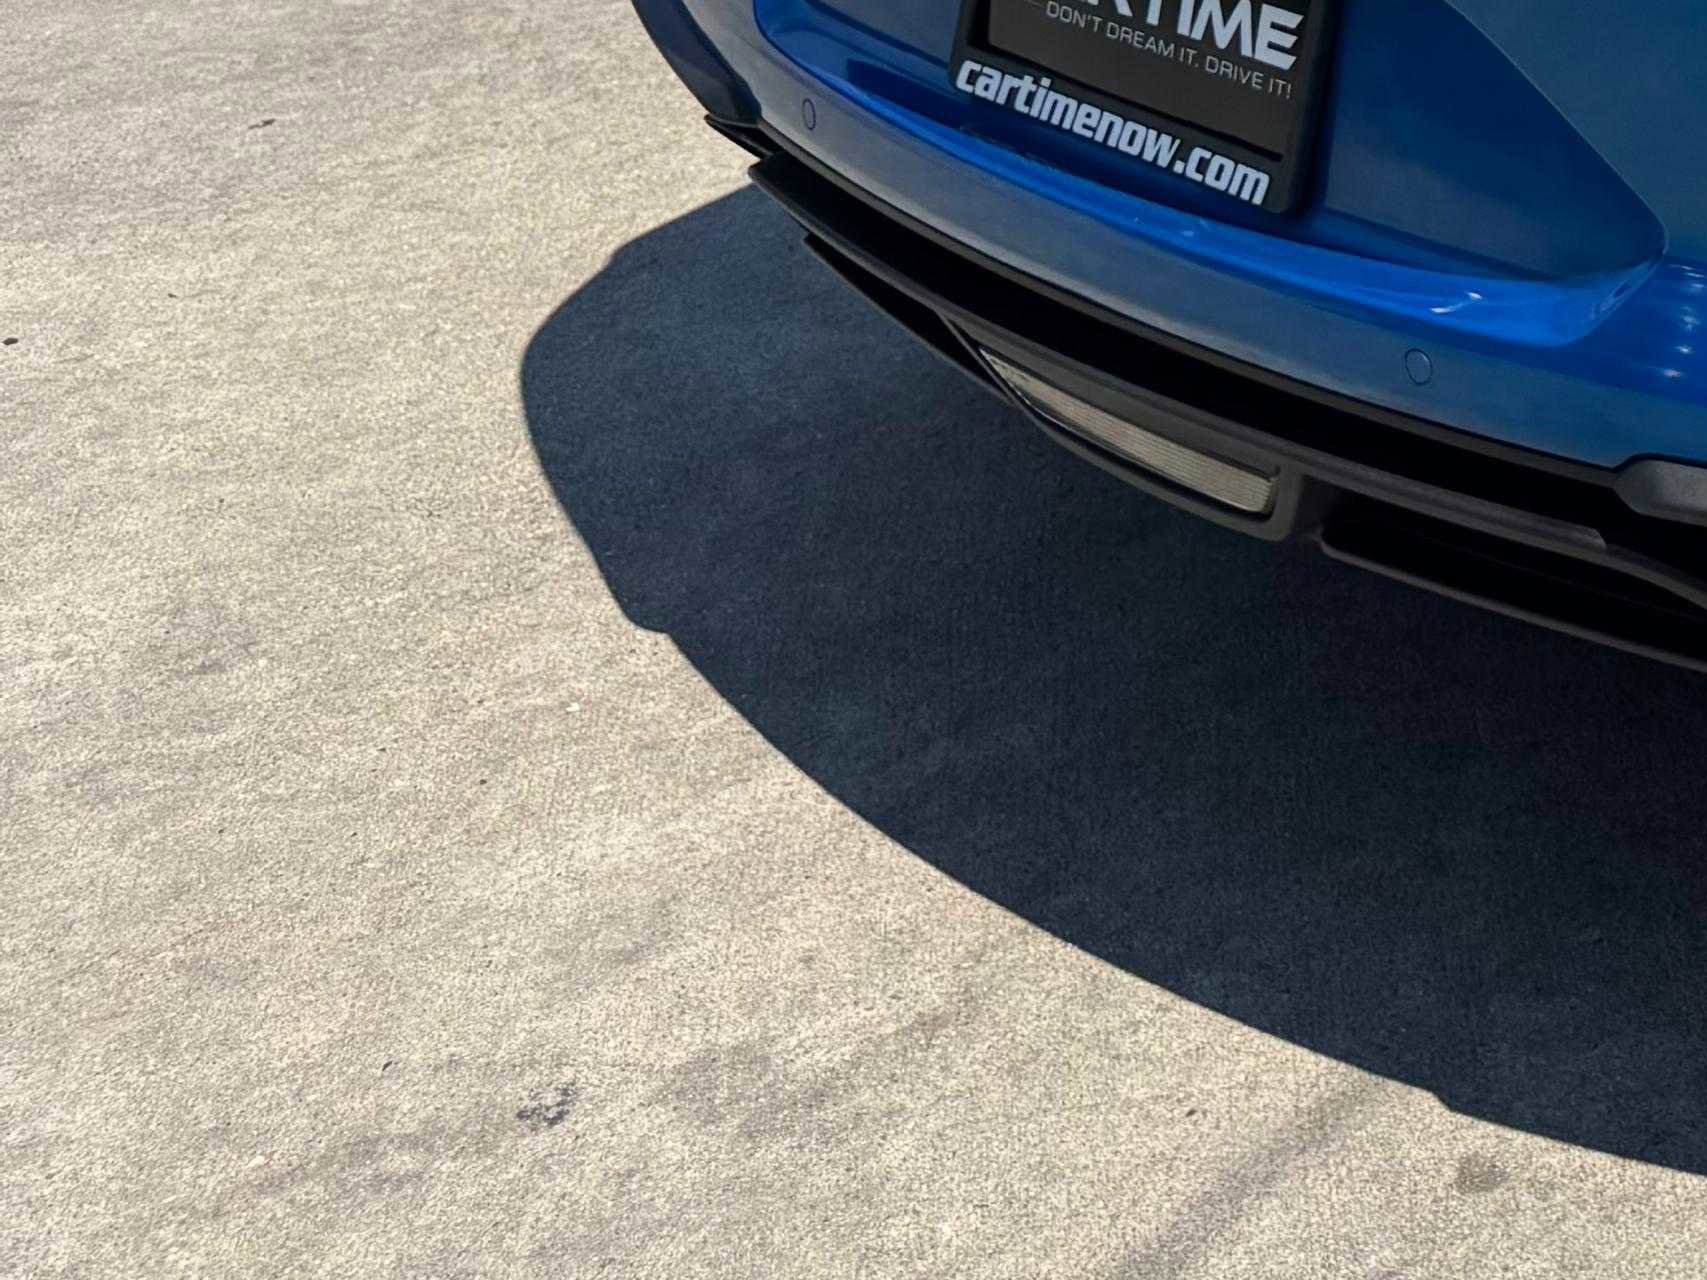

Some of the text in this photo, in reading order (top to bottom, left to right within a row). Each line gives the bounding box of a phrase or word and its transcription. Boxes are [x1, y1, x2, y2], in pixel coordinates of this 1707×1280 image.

[1045, 0, 1293, 101] DON'T DREAM IT. DRIVE IT!
[955, 60, 1271, 208] cartimenow.com
